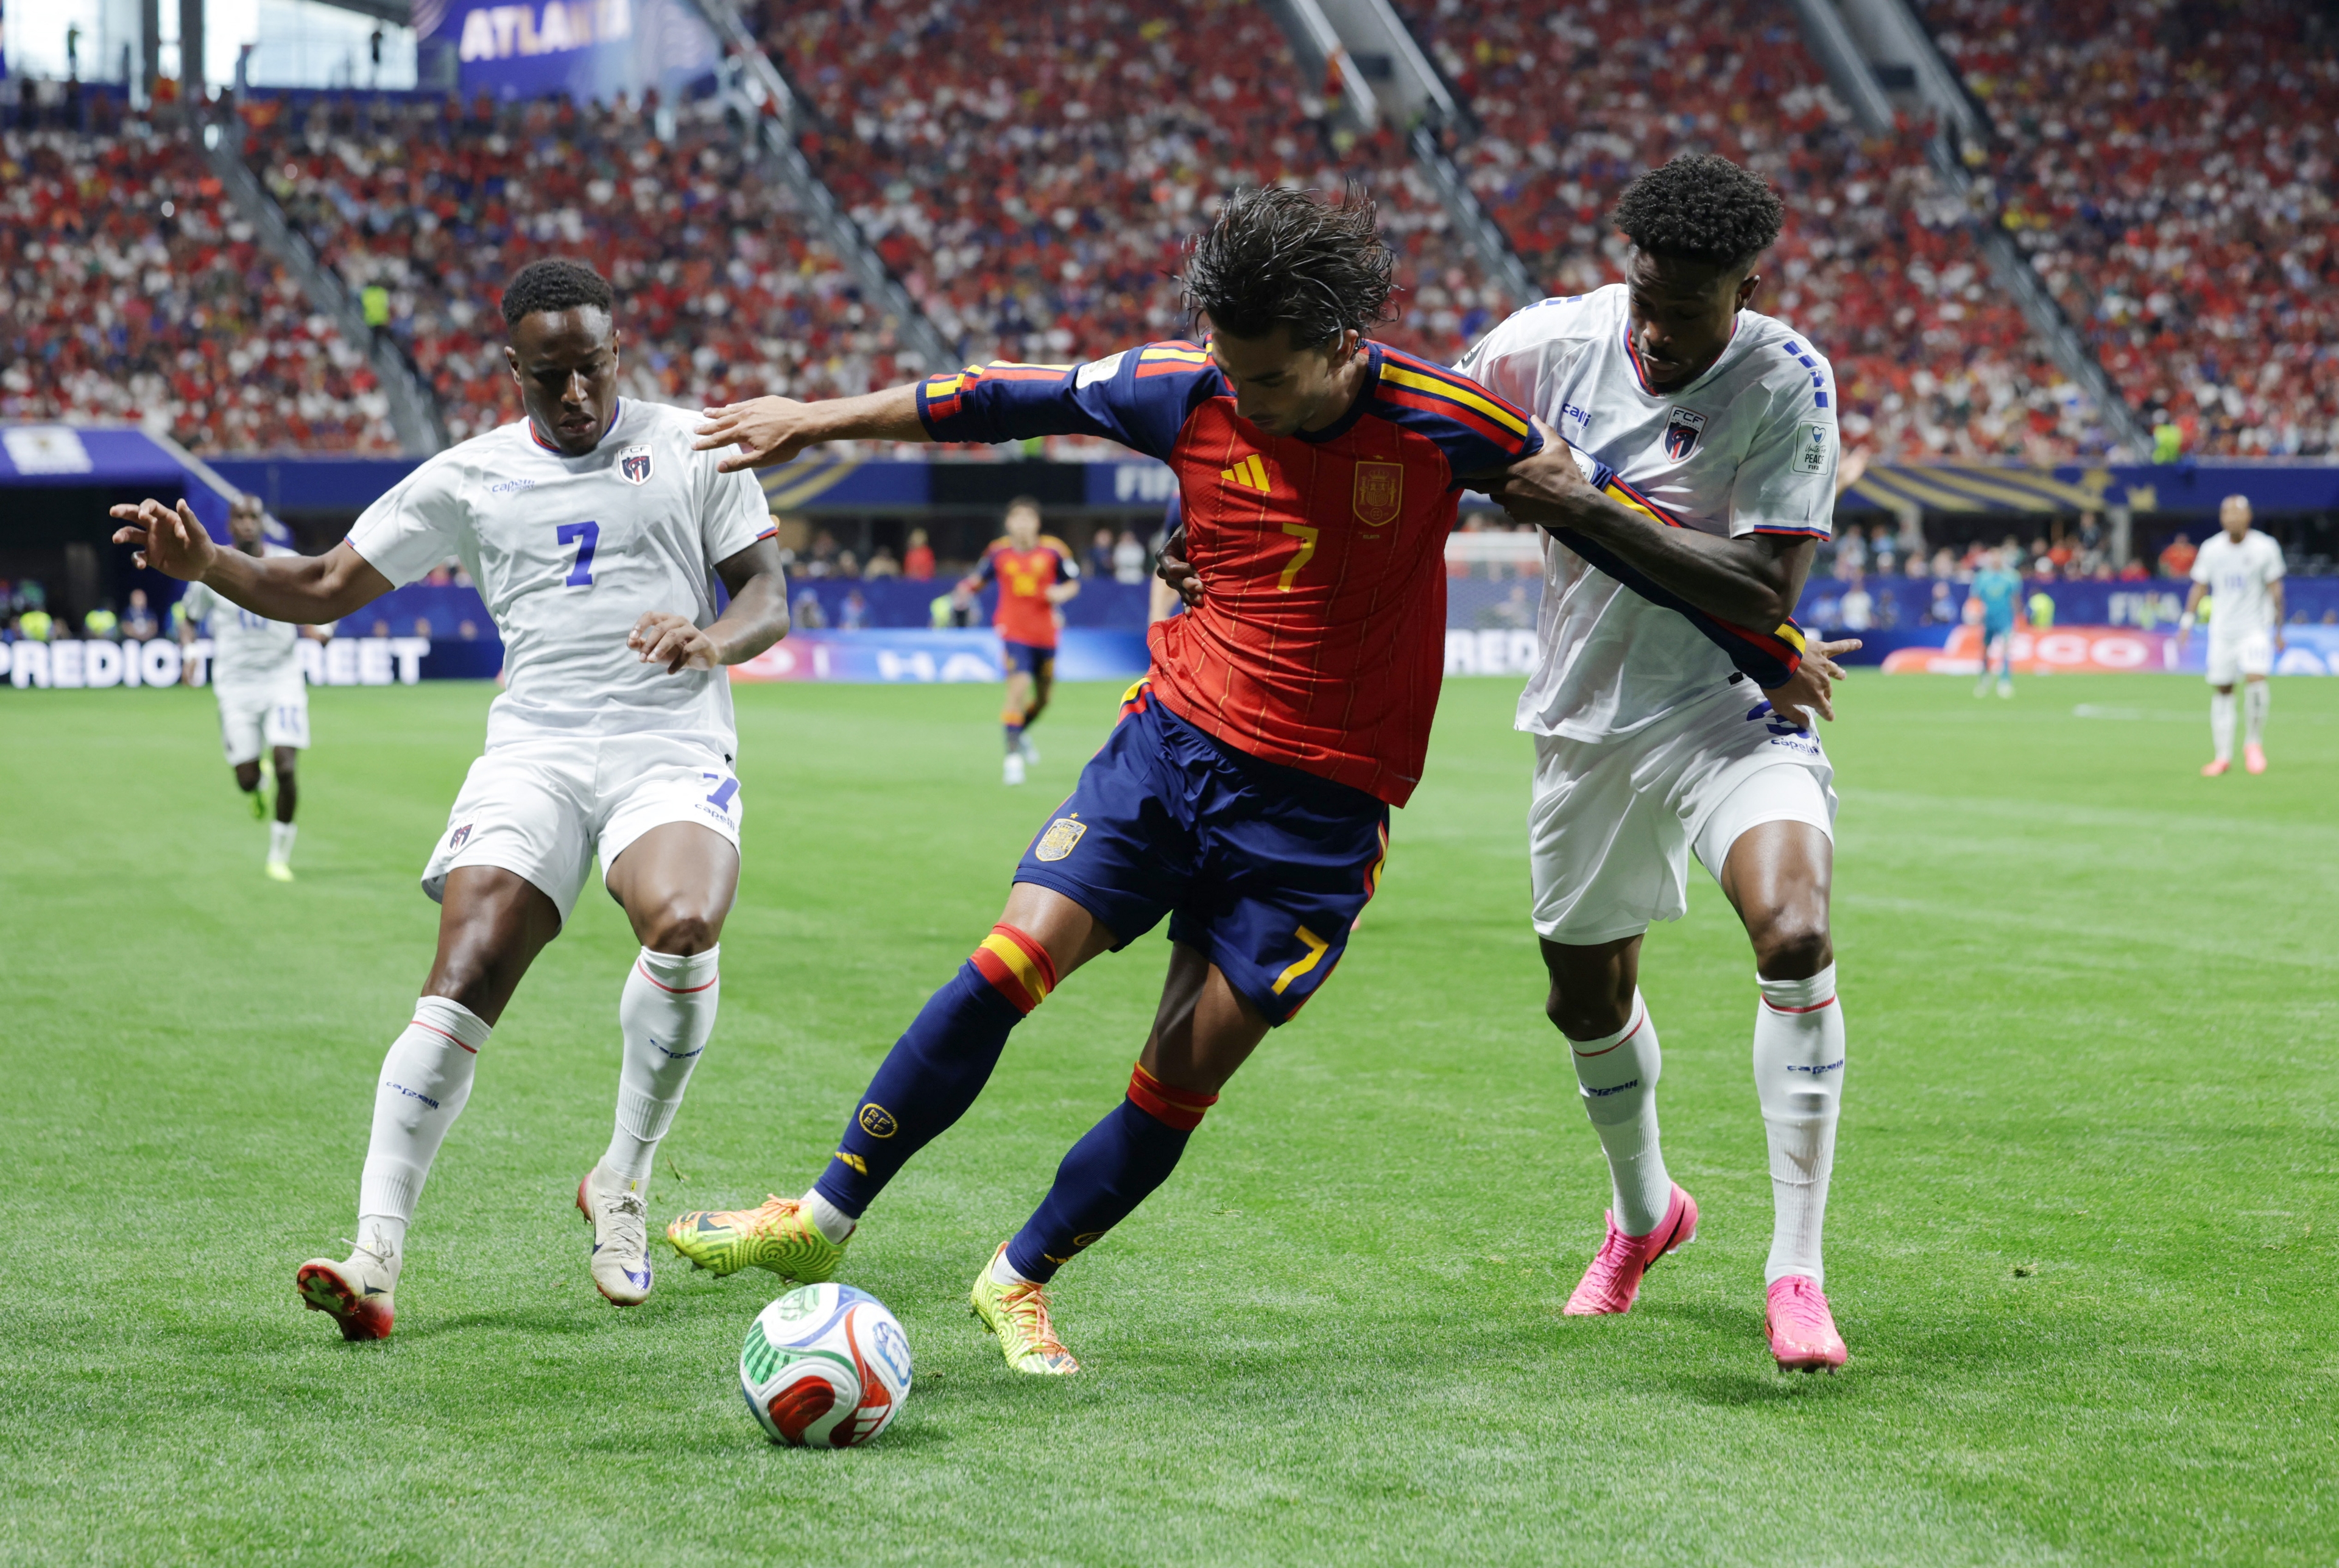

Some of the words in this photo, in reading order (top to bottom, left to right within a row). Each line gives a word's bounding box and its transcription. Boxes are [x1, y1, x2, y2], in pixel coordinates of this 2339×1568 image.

[1673, 409, 1704, 423] FCF
[621, 446, 650, 456] FCF
[557, 521, 600, 587] 7
[1277, 522, 1319, 592] 7
[703, 772, 738, 813] 7
[694, 804, 735, 832] capelli
[1271, 925, 1329, 995] 7
